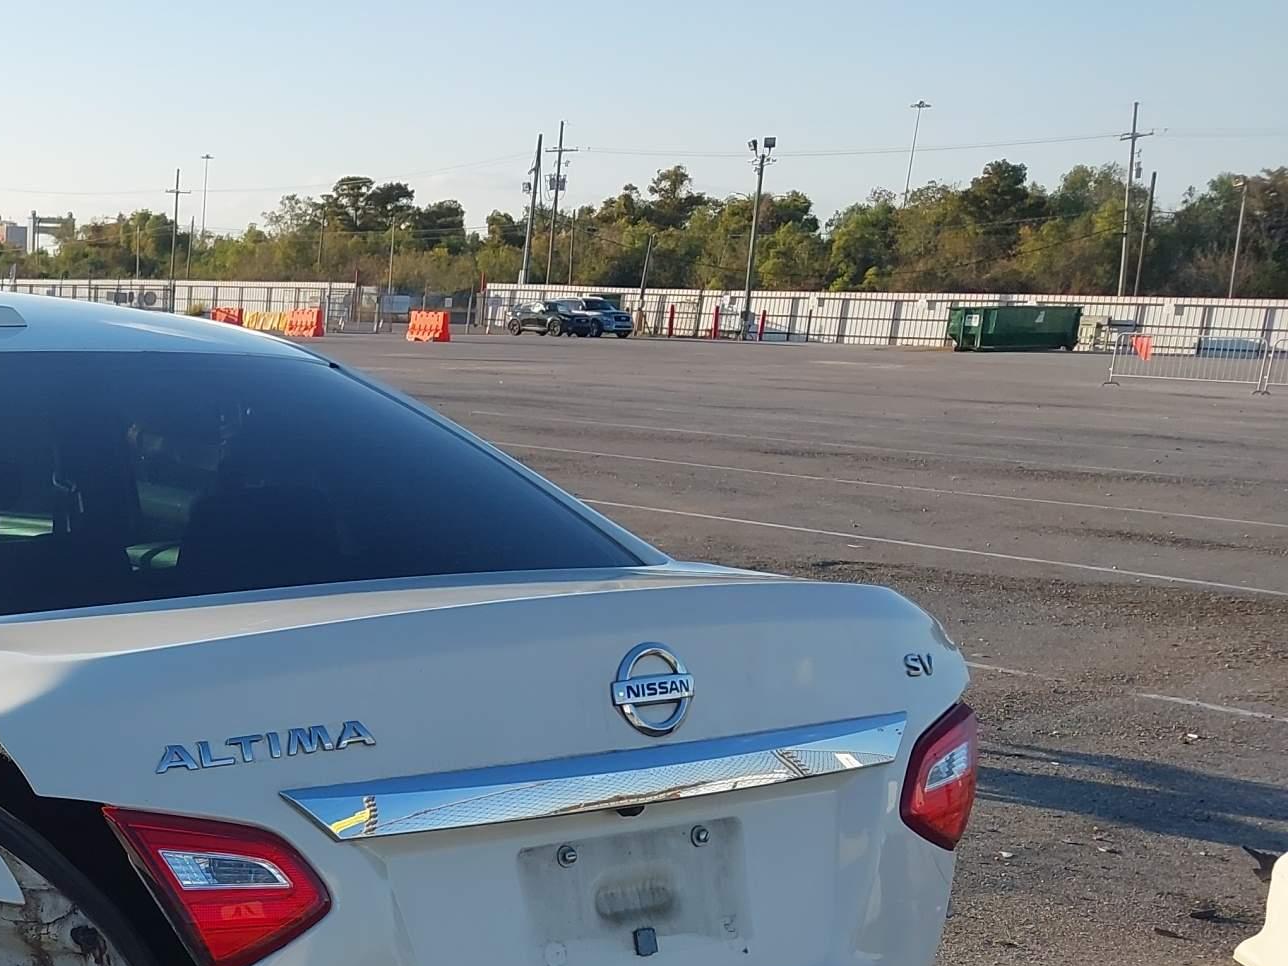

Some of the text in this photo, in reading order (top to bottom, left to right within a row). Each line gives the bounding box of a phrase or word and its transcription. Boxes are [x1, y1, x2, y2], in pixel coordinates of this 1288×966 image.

[904, 652, 934, 678] SV
[626, 679, 690, 699] NISSAN
[155, 719, 377, 775] ALTIMA
